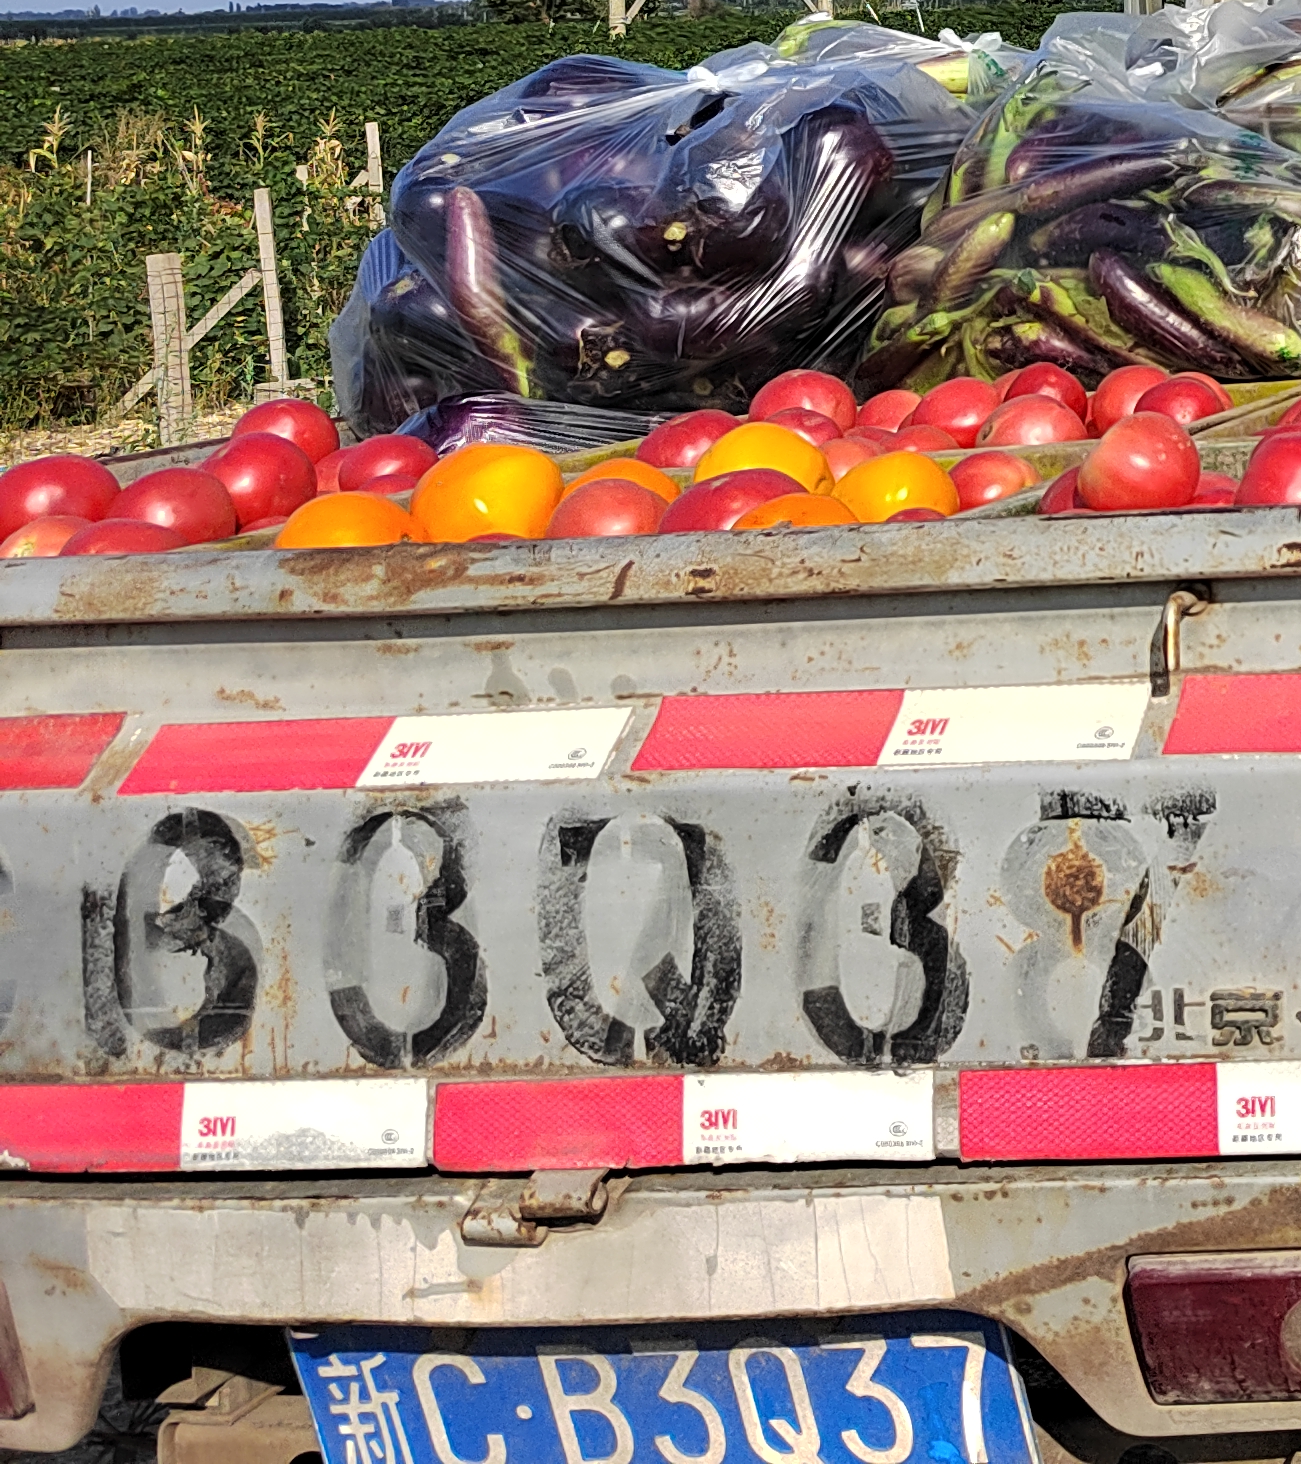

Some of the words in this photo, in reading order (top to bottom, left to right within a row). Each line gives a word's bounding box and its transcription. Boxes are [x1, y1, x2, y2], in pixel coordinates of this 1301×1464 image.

[907, 717, 950, 736] 3M
[390, 741, 433, 759] 3M
[1236, 1096, 1276, 1118] 3M
[198, 1116, 236, 1138] 3M
[700, 1108, 738, 1131] 3M
